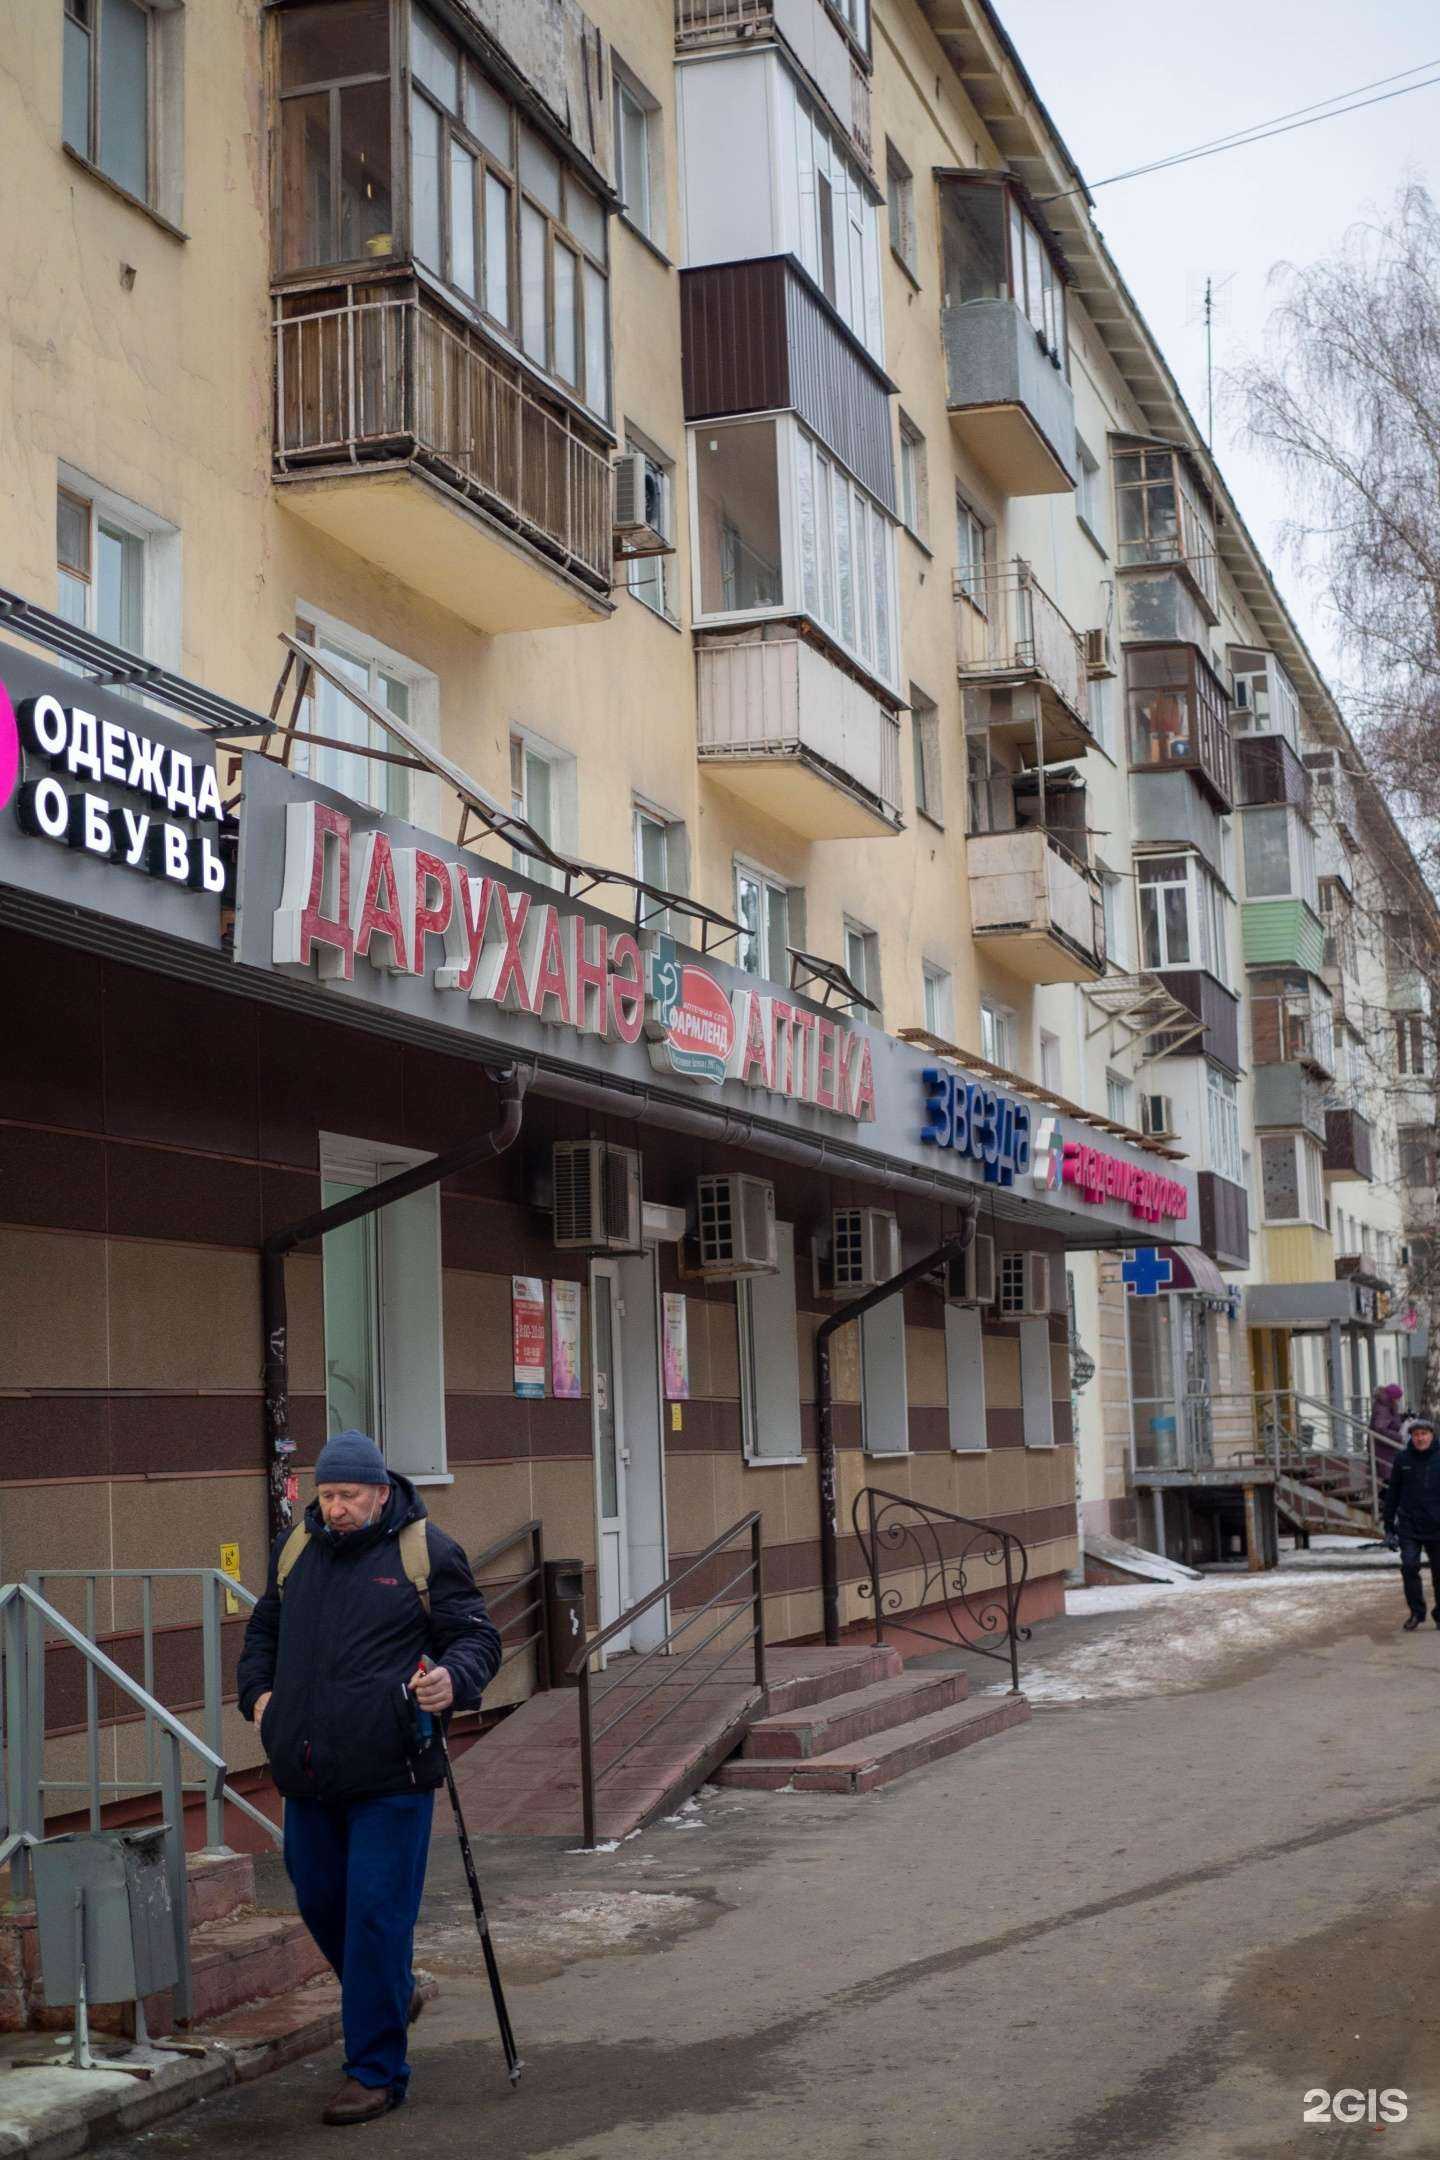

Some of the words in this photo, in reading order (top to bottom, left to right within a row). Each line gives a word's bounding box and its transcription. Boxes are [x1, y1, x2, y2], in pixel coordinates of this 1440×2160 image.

[33, 694, 225, 822] ОДЕЖДА
[34, 777, 227, 893] ОБУВЬ
[296, 800, 645, 1044] ДАРУХАНӘ
[668, 1005, 728, 1053] ФАРМЛЕНД
[740, 989, 877, 1122] АПТЕКА
